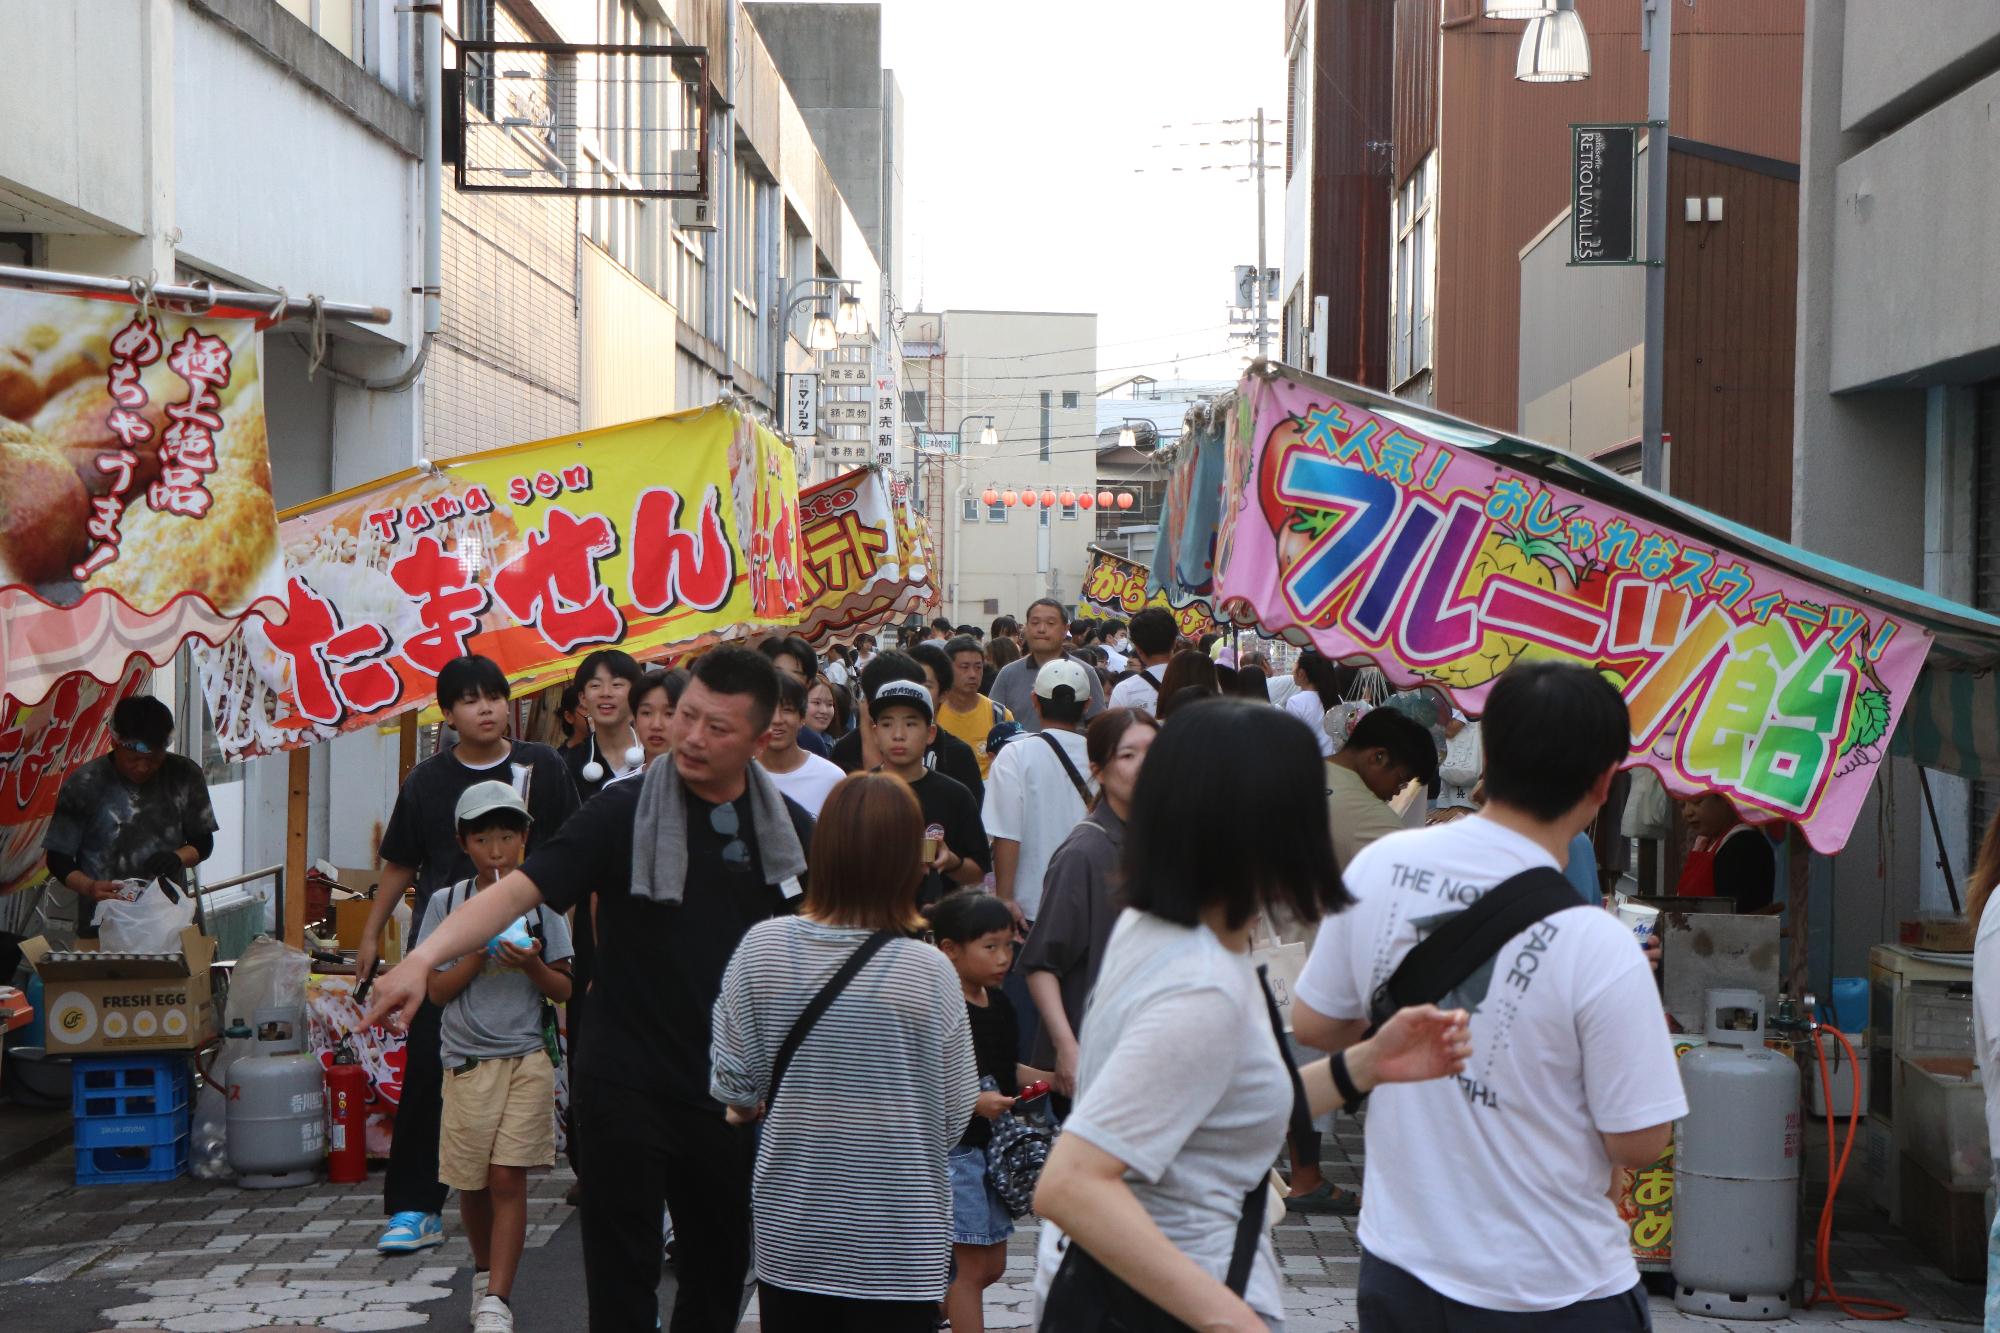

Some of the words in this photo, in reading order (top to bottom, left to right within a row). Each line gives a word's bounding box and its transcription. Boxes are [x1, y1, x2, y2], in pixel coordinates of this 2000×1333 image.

[1579, 132, 1593, 259] RETROUVAILLES
[798, 389, 809, 431] マツシタ
[830, 369, 866, 379] 贈答品
[148, 328, 231, 518] 極上絶品
[831, 446, 866, 457] 事務機
[878, 397, 893, 465] 読売新聞
[1301, 401, 1456, 492] 大人気！
[369, 484, 492, 543] Tama
[507, 462, 592, 504] sen
[262, 484, 735, 725] たません
[1279, 446, 1860, 822] フルーツ飴
[1391, 863, 1434, 894] THE
[1437, 880, 1490, 906] NO
[1505, 921, 1559, 994] FACE
[102, 994, 151, 1009] FRESH
[155, 992, 187, 1007] EGG
